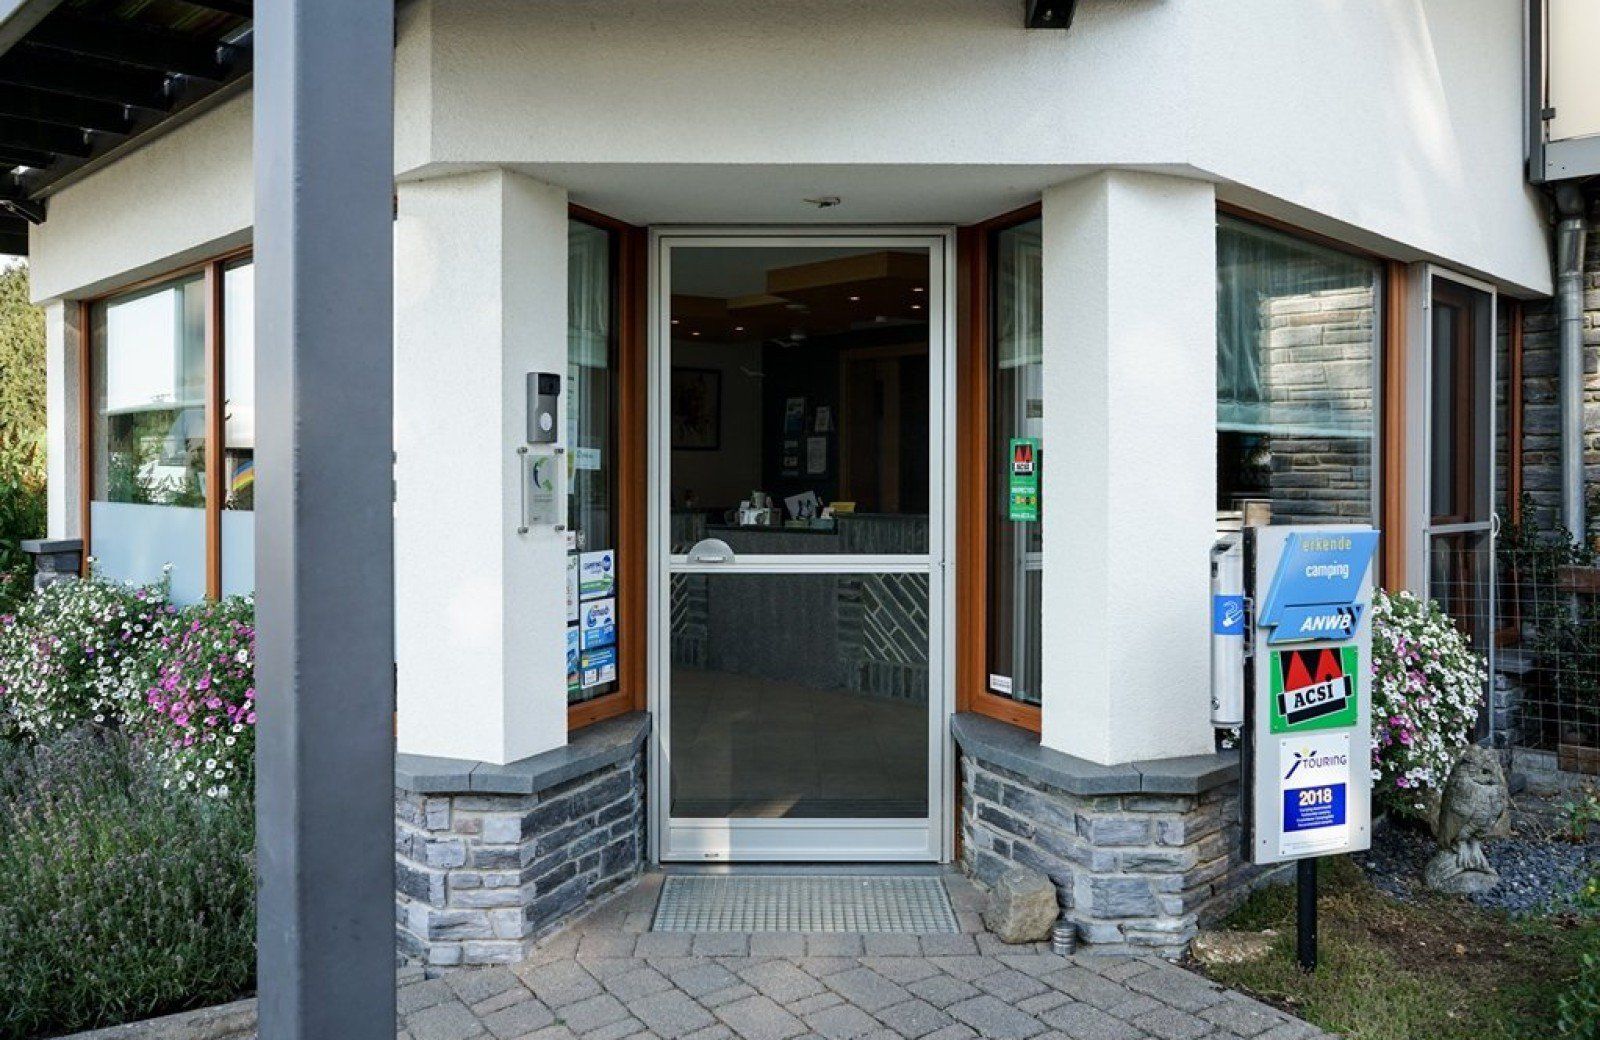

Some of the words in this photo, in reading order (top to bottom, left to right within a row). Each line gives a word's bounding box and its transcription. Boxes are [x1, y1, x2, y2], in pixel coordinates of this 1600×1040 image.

[1302, 536, 1352, 553] erkende
[1305, 561, 1349, 580] camping
[1300, 613, 1352, 632] ANWB
[1294, 684, 1334, 709] ACSI
[1303, 755, 1348, 769] TOURING
[1299, 787, 1333, 806] 2018
